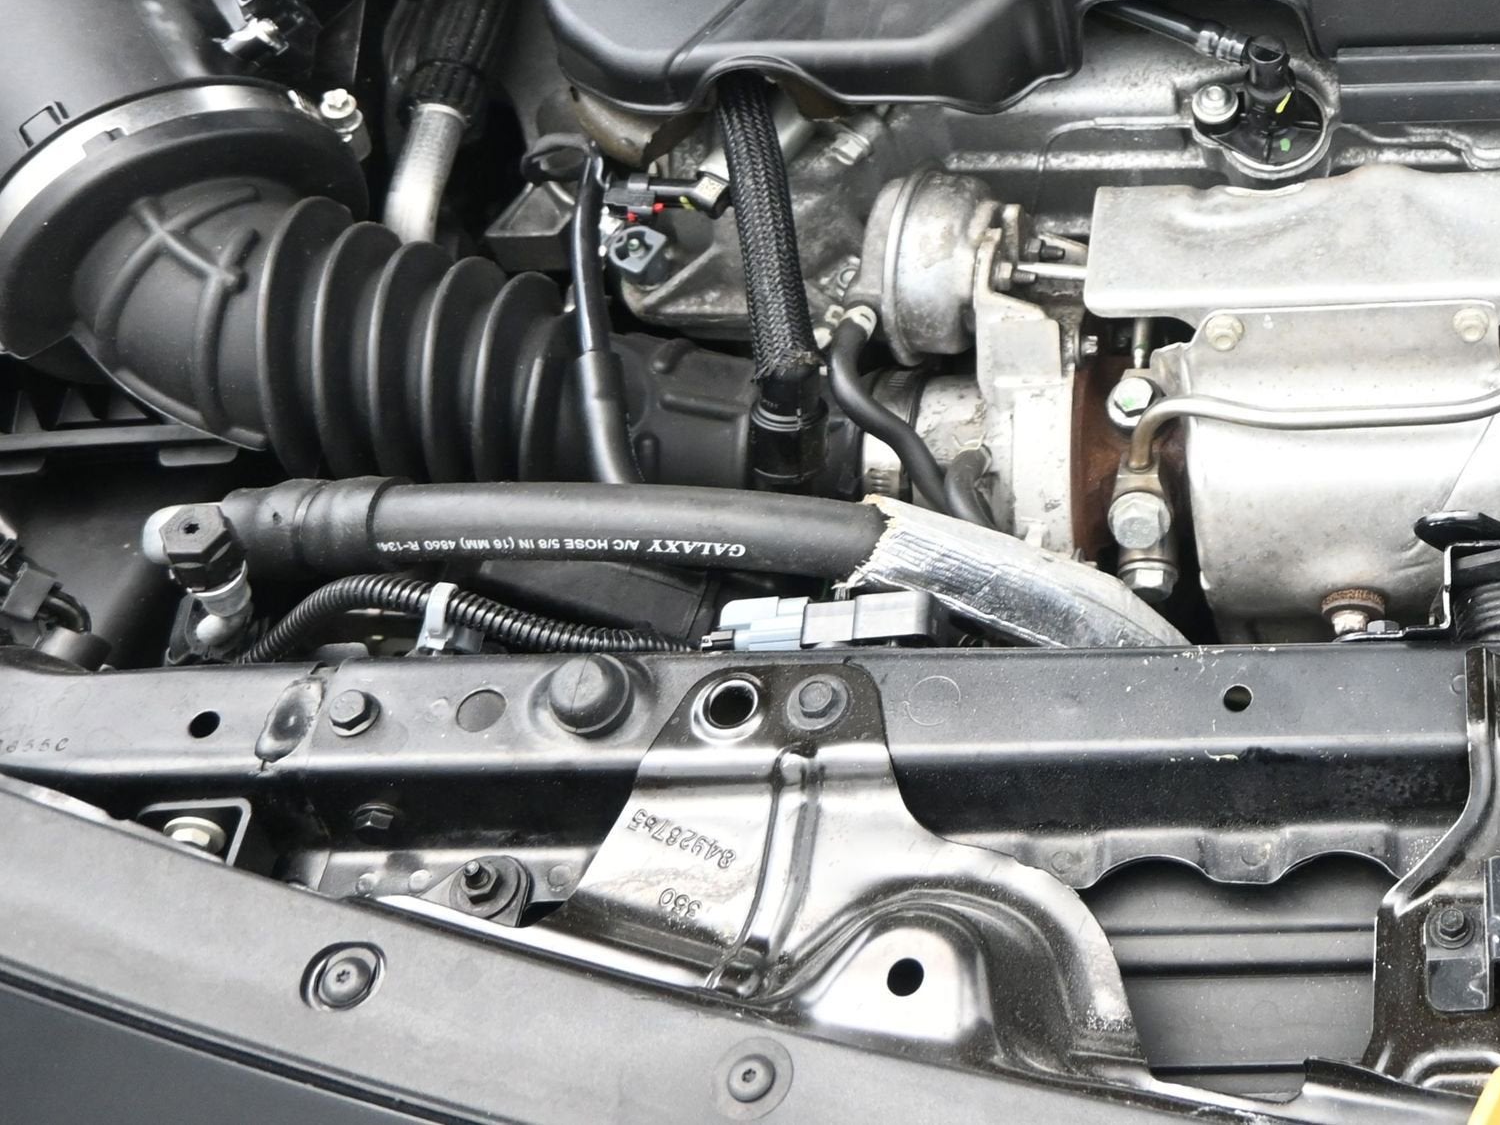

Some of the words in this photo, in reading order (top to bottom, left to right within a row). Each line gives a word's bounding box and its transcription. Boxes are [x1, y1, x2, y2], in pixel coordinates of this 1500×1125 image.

[424, 539, 456, 551] 4860
[460, 537, 490, 550] MM)
[494, 536, 515, 549] (16
[518, 539, 535, 549] IN
[538, 538, 560, 549] 5/8
[564, 538, 609, 550] HOSE
[612, 539, 640, 551] A/C
[648, 539, 746, 557] GALAXY
[658, 887, 703, 918] 350
